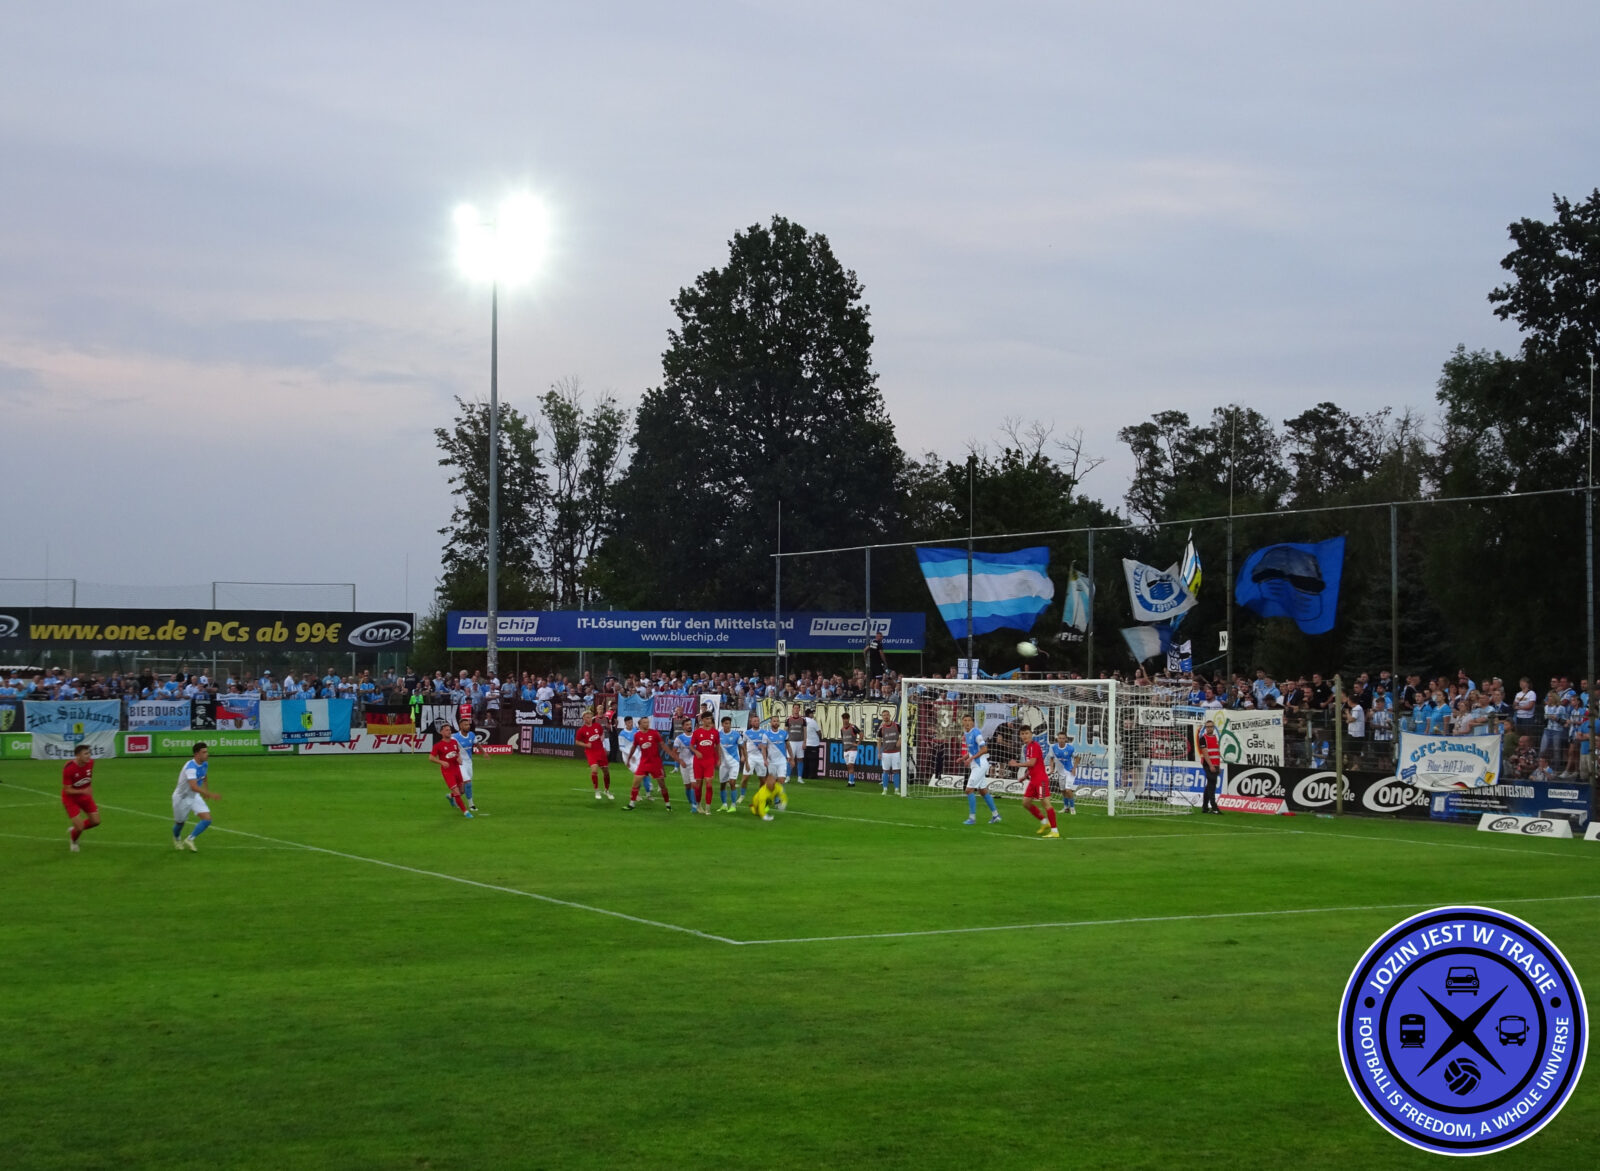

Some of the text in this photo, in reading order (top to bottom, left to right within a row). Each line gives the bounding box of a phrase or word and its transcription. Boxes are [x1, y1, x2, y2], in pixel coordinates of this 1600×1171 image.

[30, 620, 187, 641] www.one.de
[203, 621, 250, 642] PCs
[256, 621, 289, 643] ab
[295, 622, 342, 643] 99€
[461, 617, 536, 633] bluchip
[577, 617, 794, 632] IT-Lösungen für den Mittelstand
[641, 632, 729, 643] www.bluechip.de
[56, 705, 120, 727] Südkurve
[129, 706, 190, 717] BIERDURST
[533, 726, 576, 746] RUTRONIK
[1246, 738, 1266, 748] Gast
[1410, 740, 1490, 764] CFC-Fanclub
[1241, 778, 1286, 796] one.de
[1494, 784, 1534, 798] MITTELSTAND
[1378, 786, 1430, 806] one.de
[1218, 798, 1280, 811] REDDY KÜCHEN
